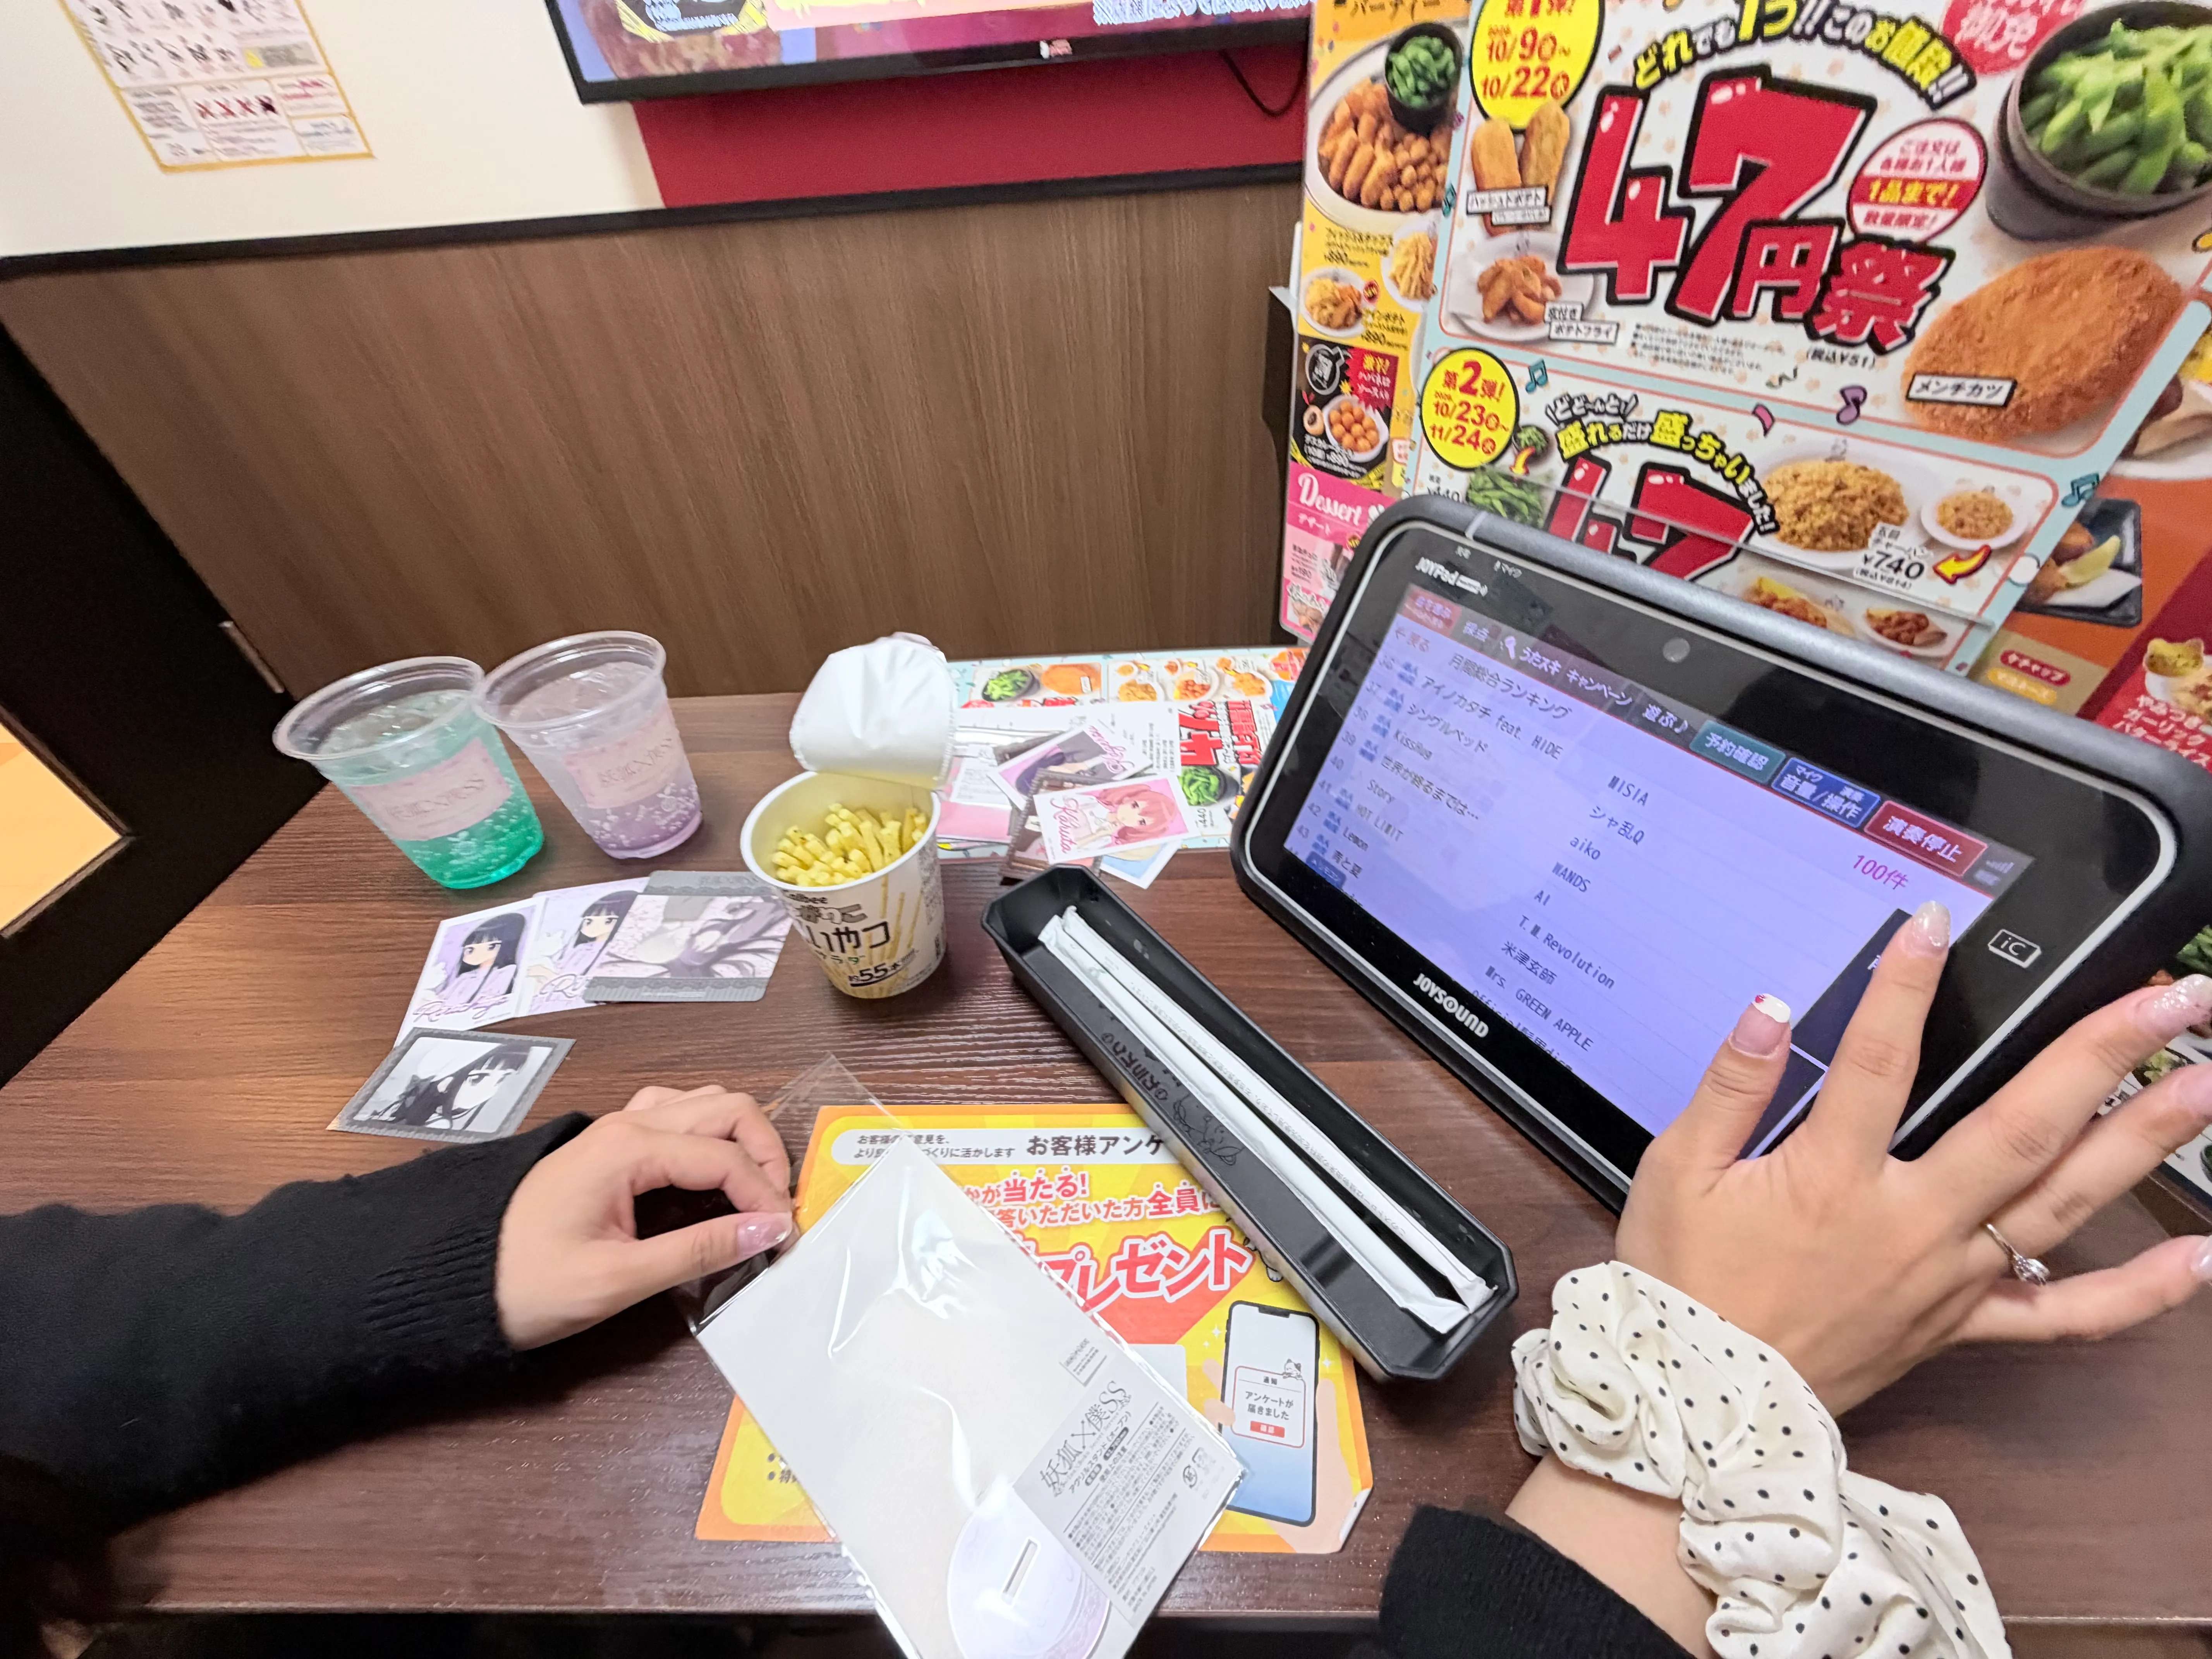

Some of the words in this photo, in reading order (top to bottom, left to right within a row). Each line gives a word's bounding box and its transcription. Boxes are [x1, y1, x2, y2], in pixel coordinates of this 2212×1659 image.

[1914, 379, 2004, 398] メンチカツ
[1298, 473, 1362, 527] Dessert
[1863, 549, 1925, 580] ¥740
[1448, 653, 1572, 719] 月間総合ランキング
[1566, 668, 1633, 706] キャンペーン
[1420, 675, 1492, 718] アイノカタチ
[1496, 714, 1522, 740] feat.
[1607, 775, 1649, 807] MISIA
[1705, 732, 1770, 771] 予約確認
[1406, 702, 1489, 754] シングルベッド
[1589, 805, 1645, 846] シャ乱Q
[1367, 778, 1395, 804] Story
[1533, 890, 1551, 907] AI
[1570, 836, 1601, 861] aiko
[1882, 816, 1963, 864] 演奏停止
[1307, 802, 1321, 817] 42
[1501, 940, 1558, 986] 米津玄師
[1852, 855, 1908, 890] 100件
[1296, 824, 1310, 840] 43
[1331, 849, 1363, 879] 青と夏
[1485, 965, 1507, 989] Mrs.
[1515, 988, 1553, 1021] GREEN
[1552, 1017, 1595, 1052] APPLE
[1413, 972, 1489, 1038] JOYSOUND
[856, 1133, 950, 1146] お客様の意見を、
[1026, 1135, 1164, 1157] お客様アンケ
[1044, 1231, 1253, 1312] プレゼント
[1245, 1391, 1294, 1409] アンケートが
[1247, 1403, 1290, 1420] 届きました
